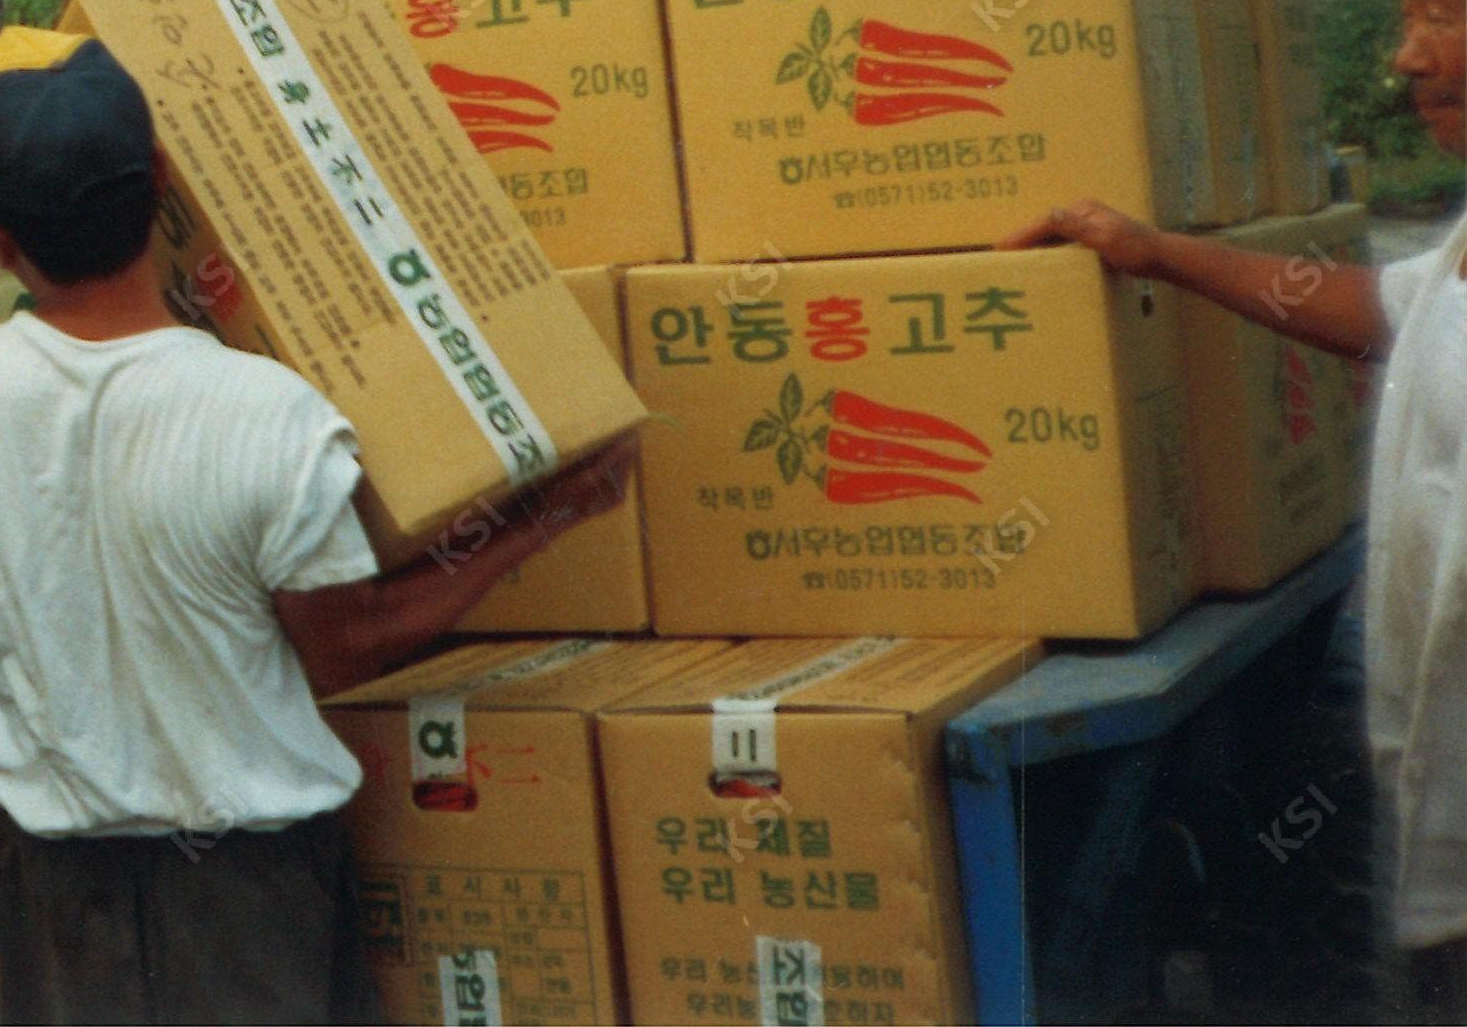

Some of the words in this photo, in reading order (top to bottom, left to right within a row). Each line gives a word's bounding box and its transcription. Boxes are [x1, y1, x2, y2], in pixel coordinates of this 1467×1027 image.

[1026, 20, 1118, 59] 20kg
[570, 61, 650, 99] 20kg
[650, 286, 1033, 366] 안동홍고추
[1004, 406, 1101, 451] 20kg
[656, 816, 730, 855] 우리
[661, 867, 736, 905] 우리
[761, 868, 880, 912] 농산물
